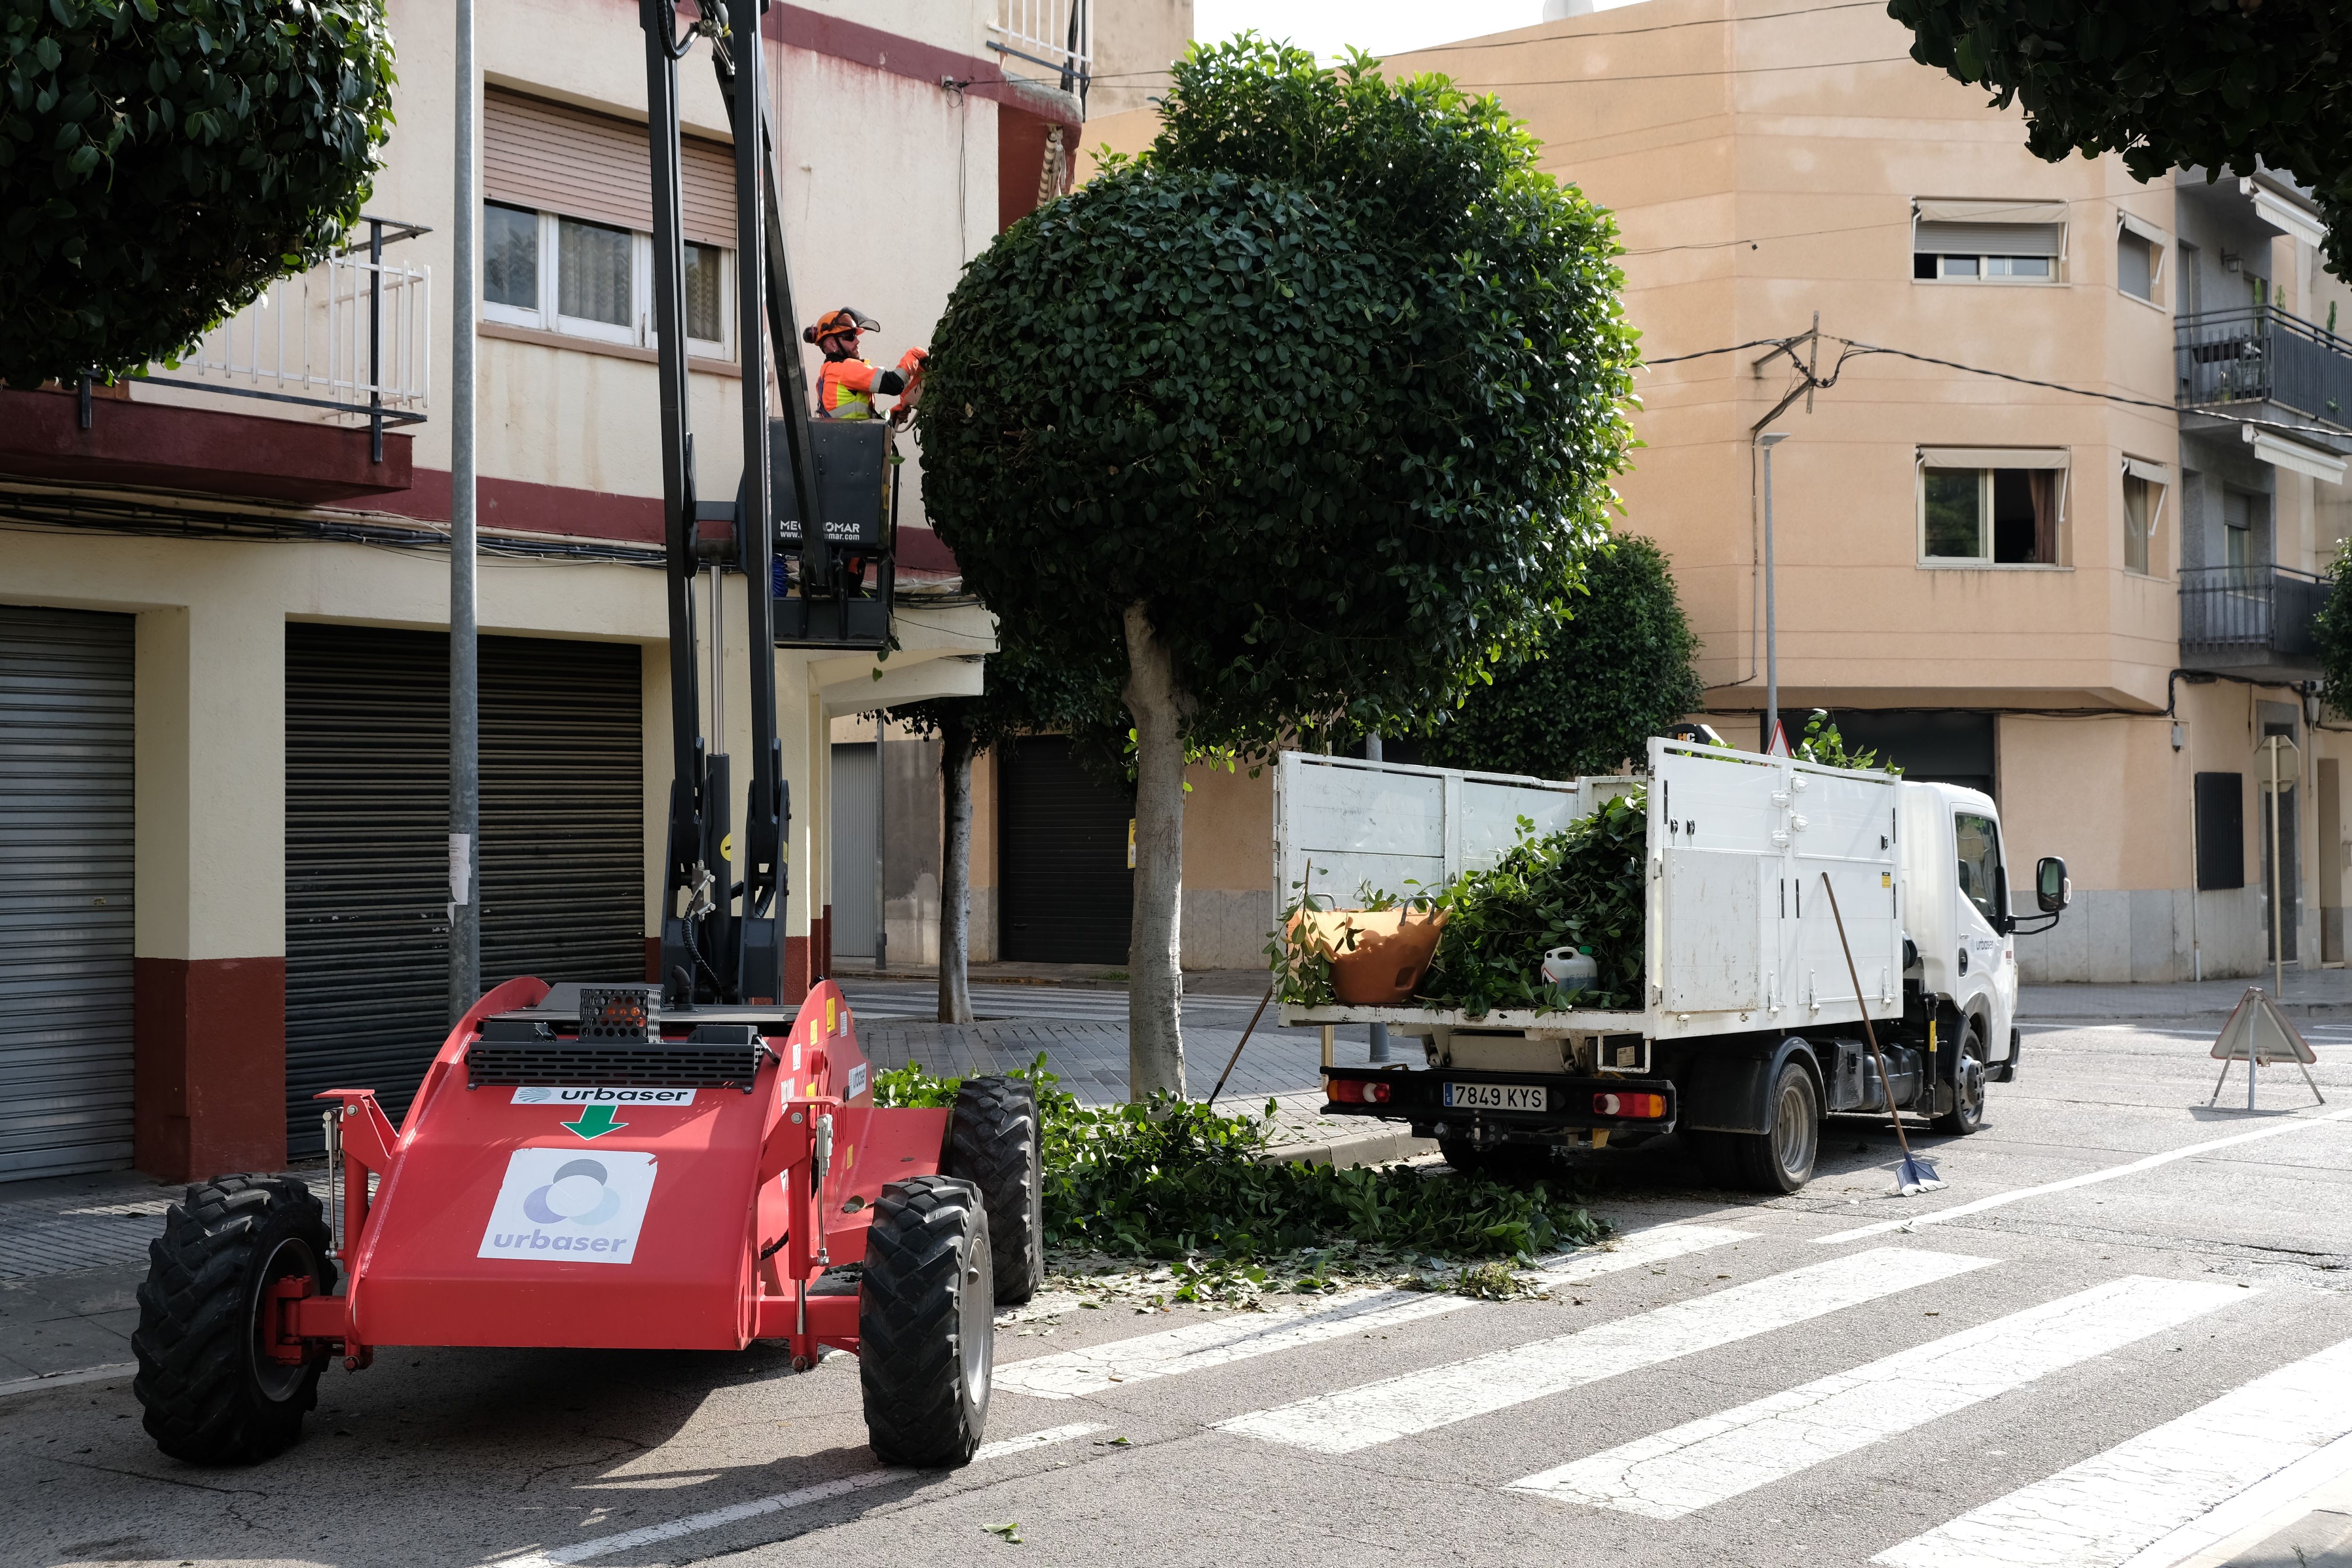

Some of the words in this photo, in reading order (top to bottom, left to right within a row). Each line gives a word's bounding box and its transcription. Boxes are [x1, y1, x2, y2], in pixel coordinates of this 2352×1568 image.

[853, 1067, 866, 1089] urbaser
[561, 1088, 688, 1101] urbaser
[1456, 1086, 1501, 1106] 7849
[1508, 1088, 1542, 1107] KYS
[494, 1229, 628, 1252] urbaser
